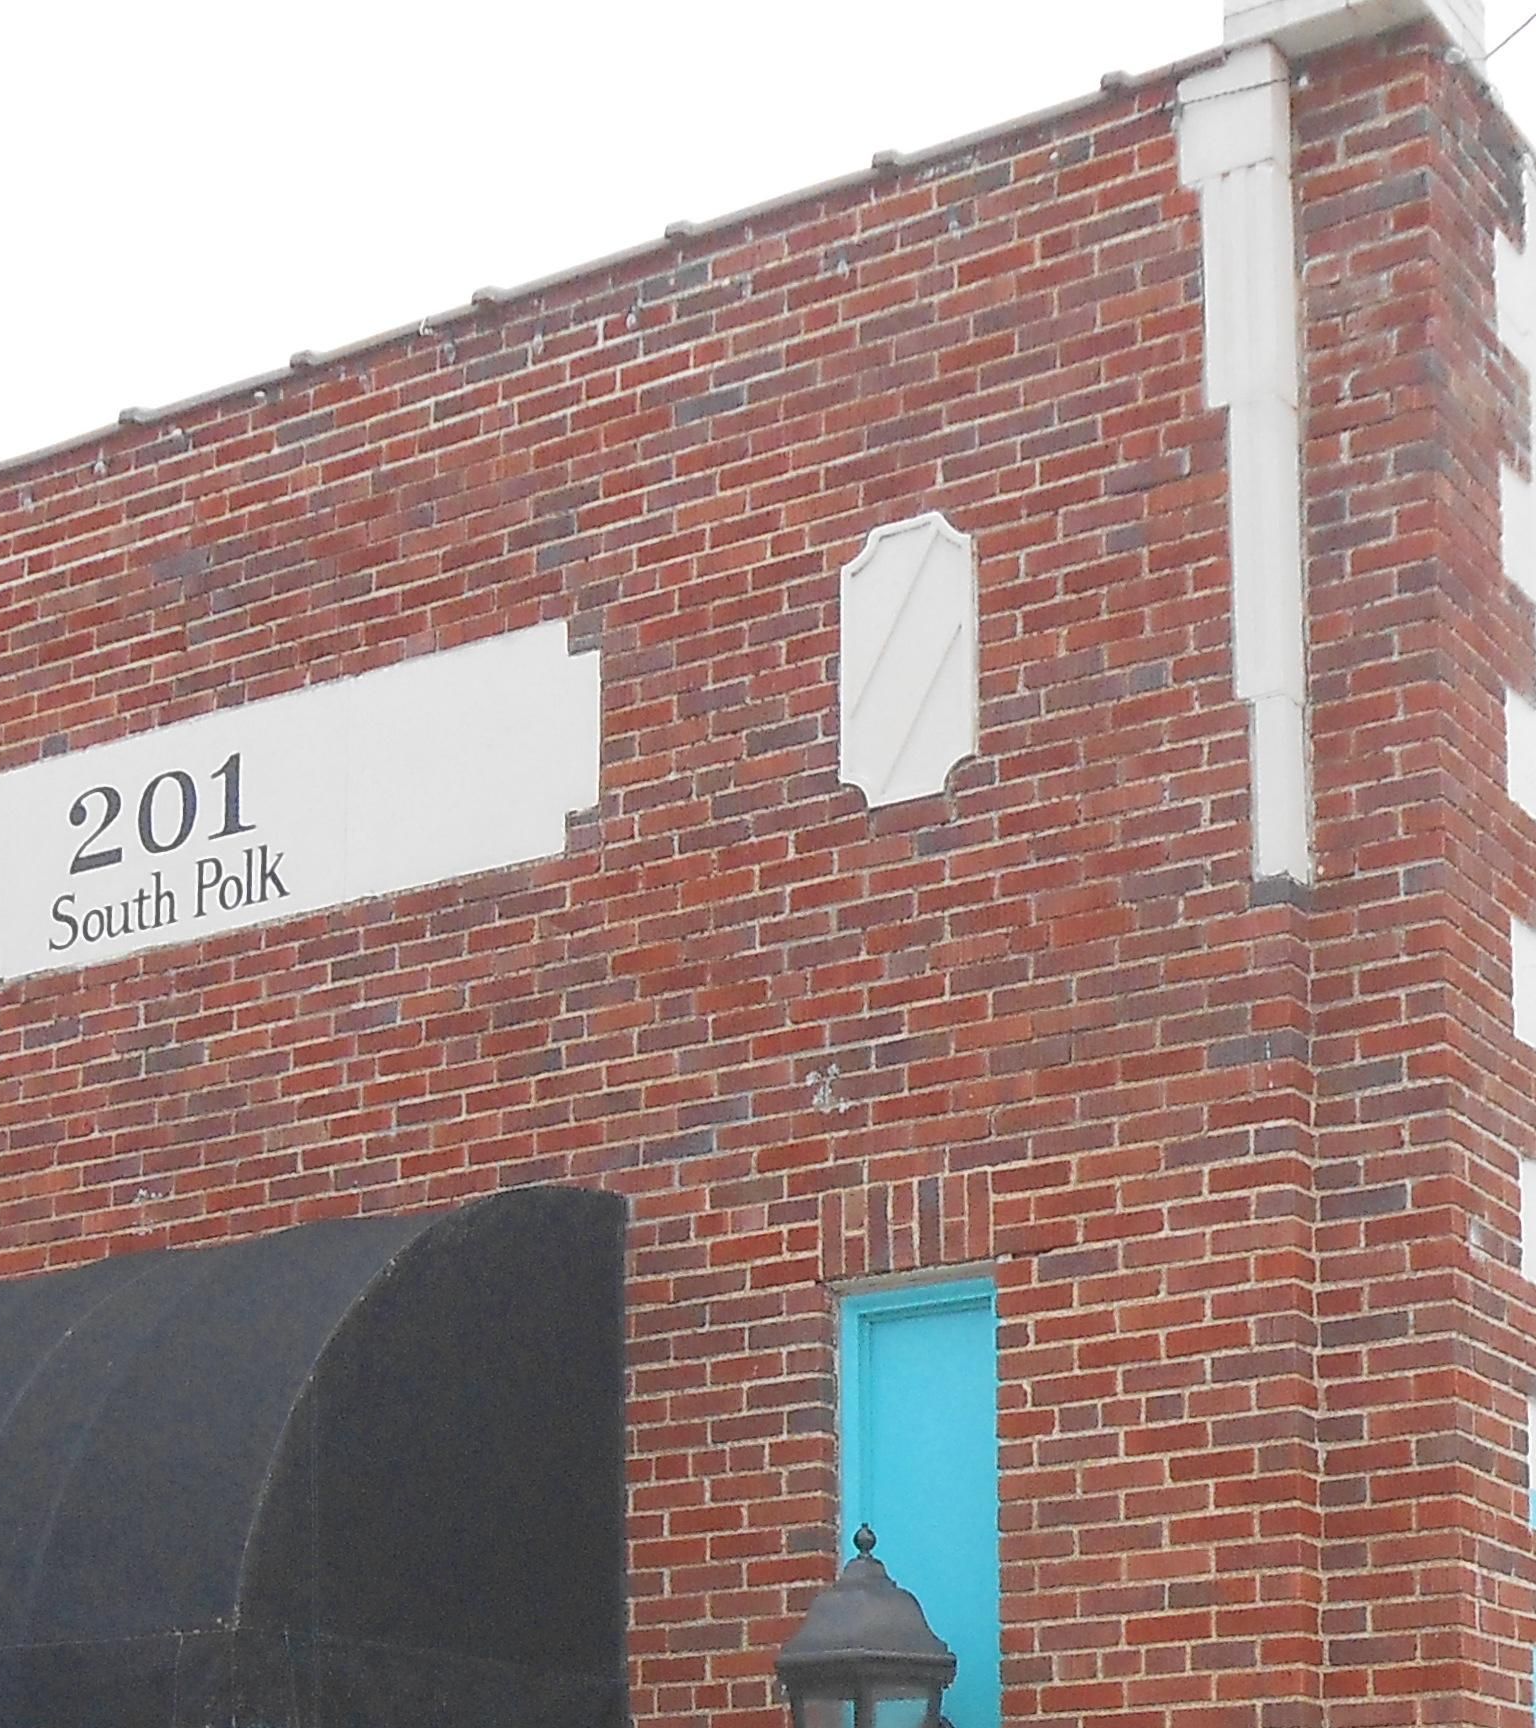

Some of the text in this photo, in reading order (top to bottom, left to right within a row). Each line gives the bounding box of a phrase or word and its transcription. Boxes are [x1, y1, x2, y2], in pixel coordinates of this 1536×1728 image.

[68, 752, 257, 875] 201
[48, 844, 291, 951] South Polk
